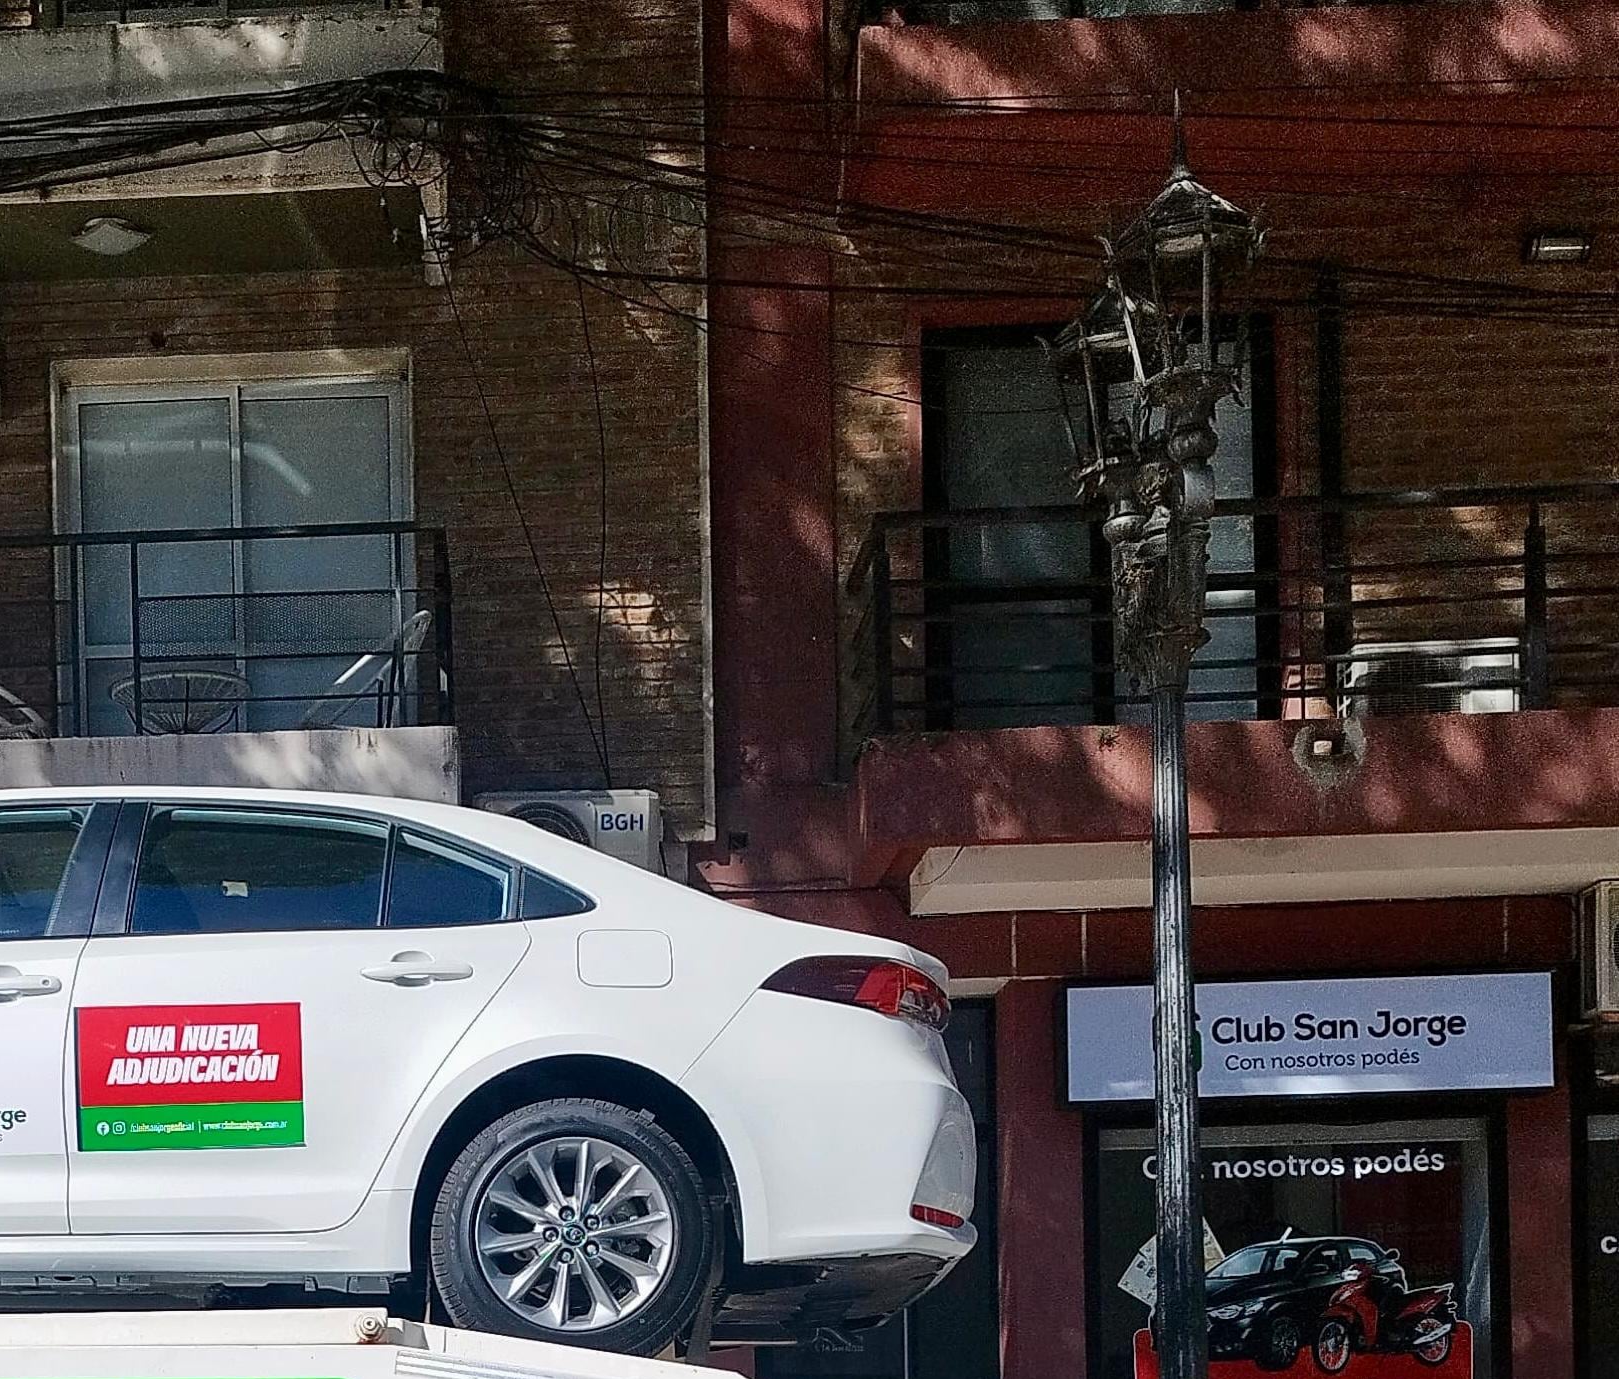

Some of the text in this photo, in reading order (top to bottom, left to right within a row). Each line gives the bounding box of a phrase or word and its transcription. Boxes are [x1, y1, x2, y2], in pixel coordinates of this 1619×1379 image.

[600, 813, 644, 832] BGH
[126, 1024, 258, 1052] UNA NUEVA
[1212, 1011, 1467, 1046] Club San Jorge
[106, 1050, 279, 1085] ADJUDICACIÓN
[1225, 1048, 1420, 1070] Con nosotros podés
[1212, 1155, 1345, 1179] nosotros
[1353, 1148, 1445, 1180] podés
